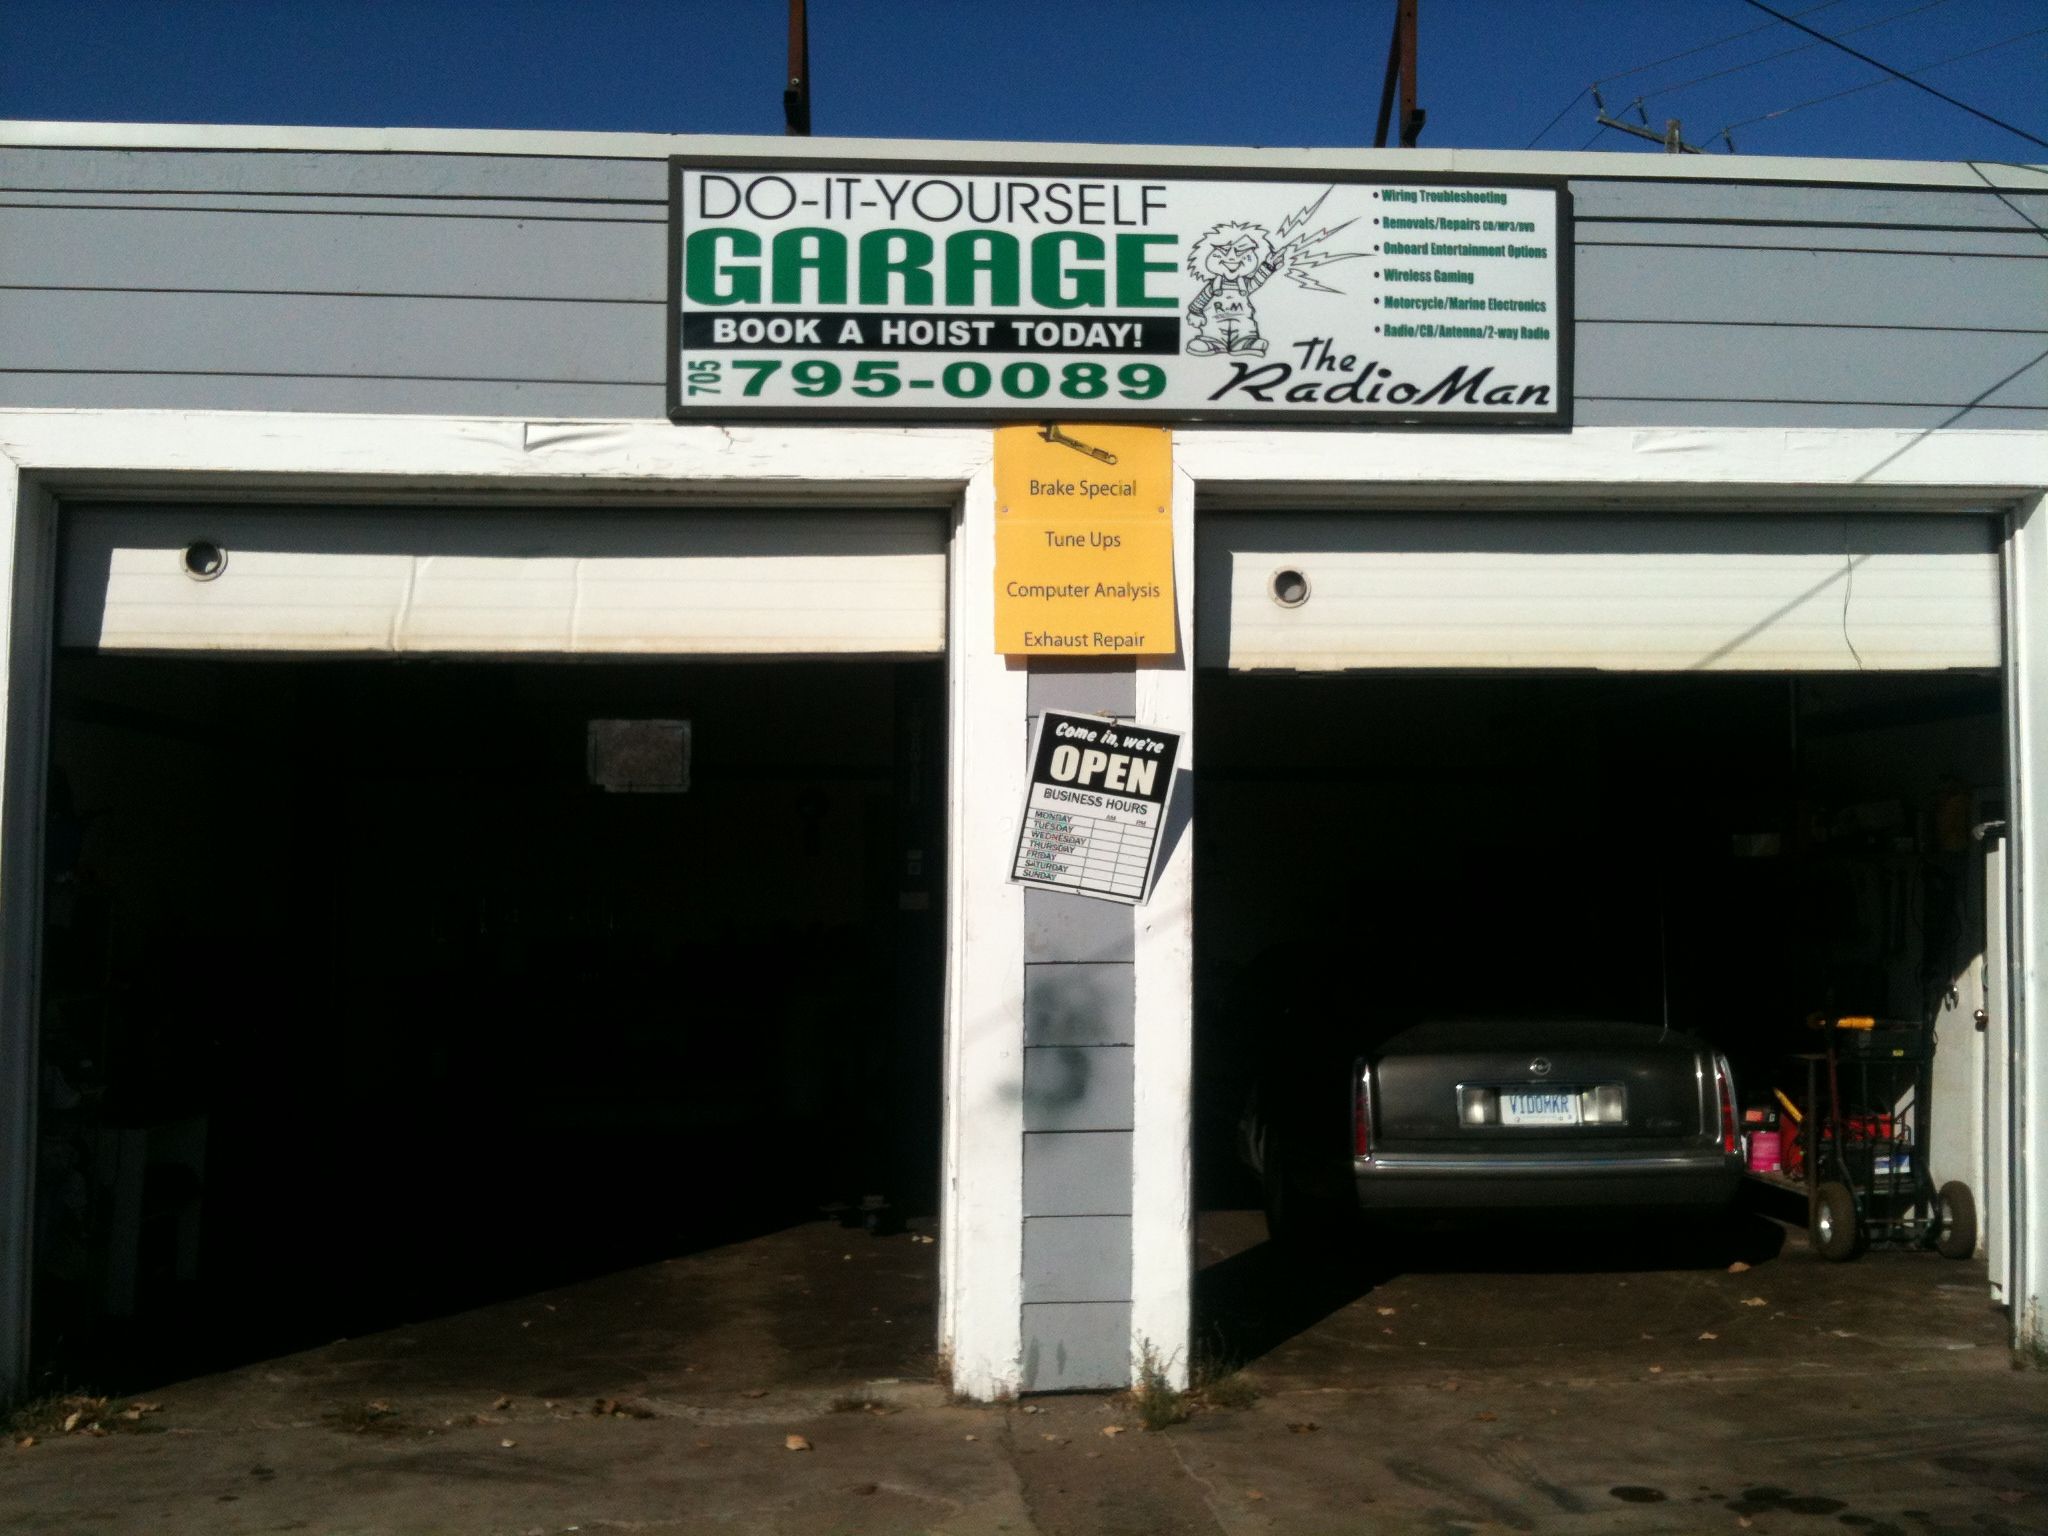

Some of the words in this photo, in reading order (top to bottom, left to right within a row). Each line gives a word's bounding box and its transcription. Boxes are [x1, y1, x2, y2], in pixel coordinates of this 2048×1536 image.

[699, 174, 1167, 226] DO-IT-YOURSELF
[1381, 189, 1418, 204] Wiring
[1419, 189, 1508, 206] Troubleshooting
[1382, 216, 1481, 232] Removals/Repairs
[1383, 241, 1429, 256] Onboard
[1430, 242, 1506, 258] Entertainment
[1507, 244, 1548, 259] Options
[685, 227, 1180, 310] GARAGE
[1383, 268, 1432, 282] Wireless
[1433, 269, 1475, 285] Gaming
[1384, 295, 1486, 312] Motorcycle/Marine
[1487, 297, 1547, 313] Electronics
[712, 318, 822, 346] BOOK
[837, 319, 864, 345] A
[881, 319, 995, 347] HOIST
[1011, 321, 1143, 349] TODAY!
[1383, 323, 1519, 341] Radio/CB/Antenna/2-way
[1520, 325, 1550, 341] Radio
[1292, 336, 1357, 373] The
[687, 360, 722, 397] 705
[731, 360, 1168, 401] 795-0089
[1030, 480, 1075, 496] Brake
[1079, 480, 1137, 500] Special
[1045, 531, 1085, 547] Tune
[1090, 532, 1121, 551] Ups
[1006, 581, 1090, 601] Computer
[1094, 582, 1161, 602] Analysis
[1024, 631, 1089, 648] Exhaust
[1093, 632, 1146, 651] Repair
[1055, 722, 1097, 742] Come
[1101, 730, 1119, 748] in,
[1123, 736, 1165, 754] we're
[1050, 744, 1158, 796] OPEN
[1044, 788, 1103, 807] BUSINESS
[1106, 798, 1149, 816] HOURS
[1034, 810, 1073, 823] MONDAY
[1033, 820, 1074, 834] TUESDAY
[1029, 840, 1076, 855] THURSDAY
[1031, 831, 1088, 846] WEDNESDAY
[1026, 850, 1057, 861] FRIDAY
[1022, 870, 1057, 881] SUNDAY
[1024, 860, 1069, 873] SATURDAY
